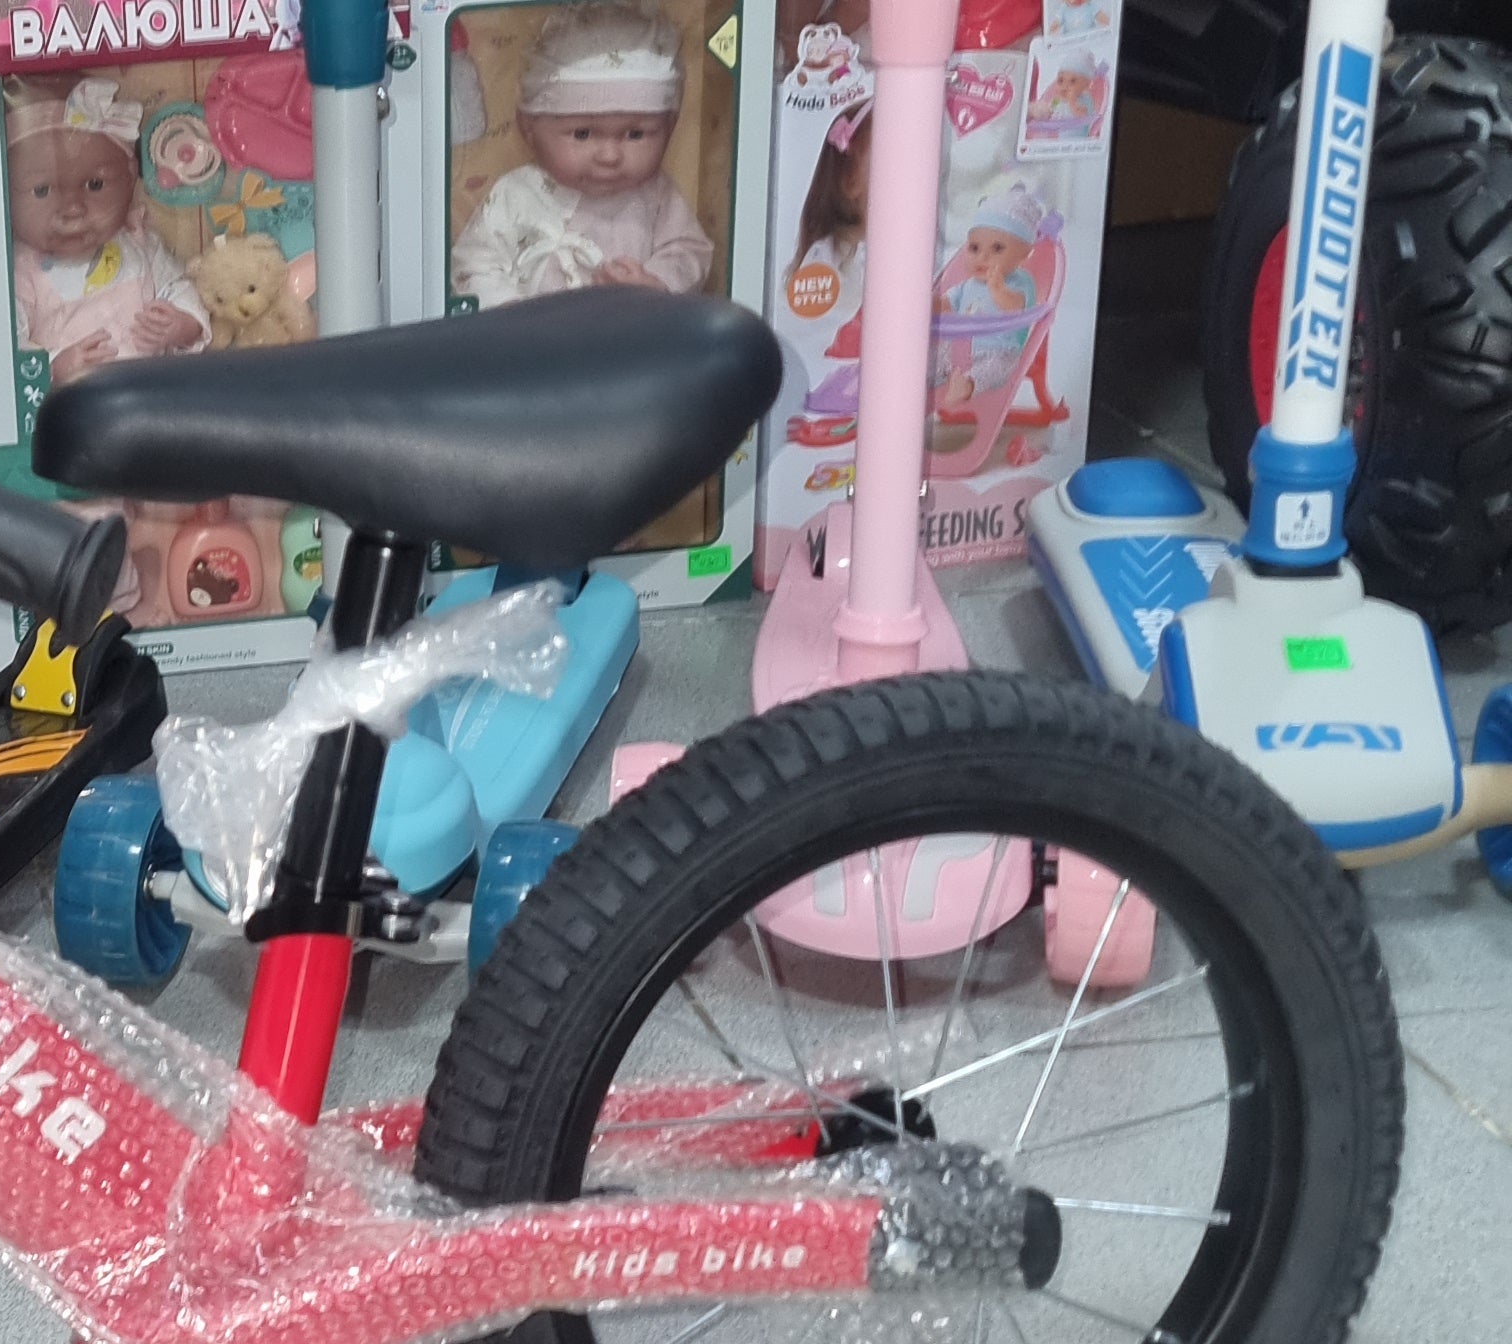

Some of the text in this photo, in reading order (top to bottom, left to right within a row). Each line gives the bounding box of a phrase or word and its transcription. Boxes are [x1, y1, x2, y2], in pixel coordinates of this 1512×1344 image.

[1301, 104, 1367, 392] SCOOTER
[794, 275, 833, 293] NEW
[794, 292, 832, 307] STYLE
[918, 505, 1004, 550] EEDING
[573, 1238, 807, 1281] Kids bike
